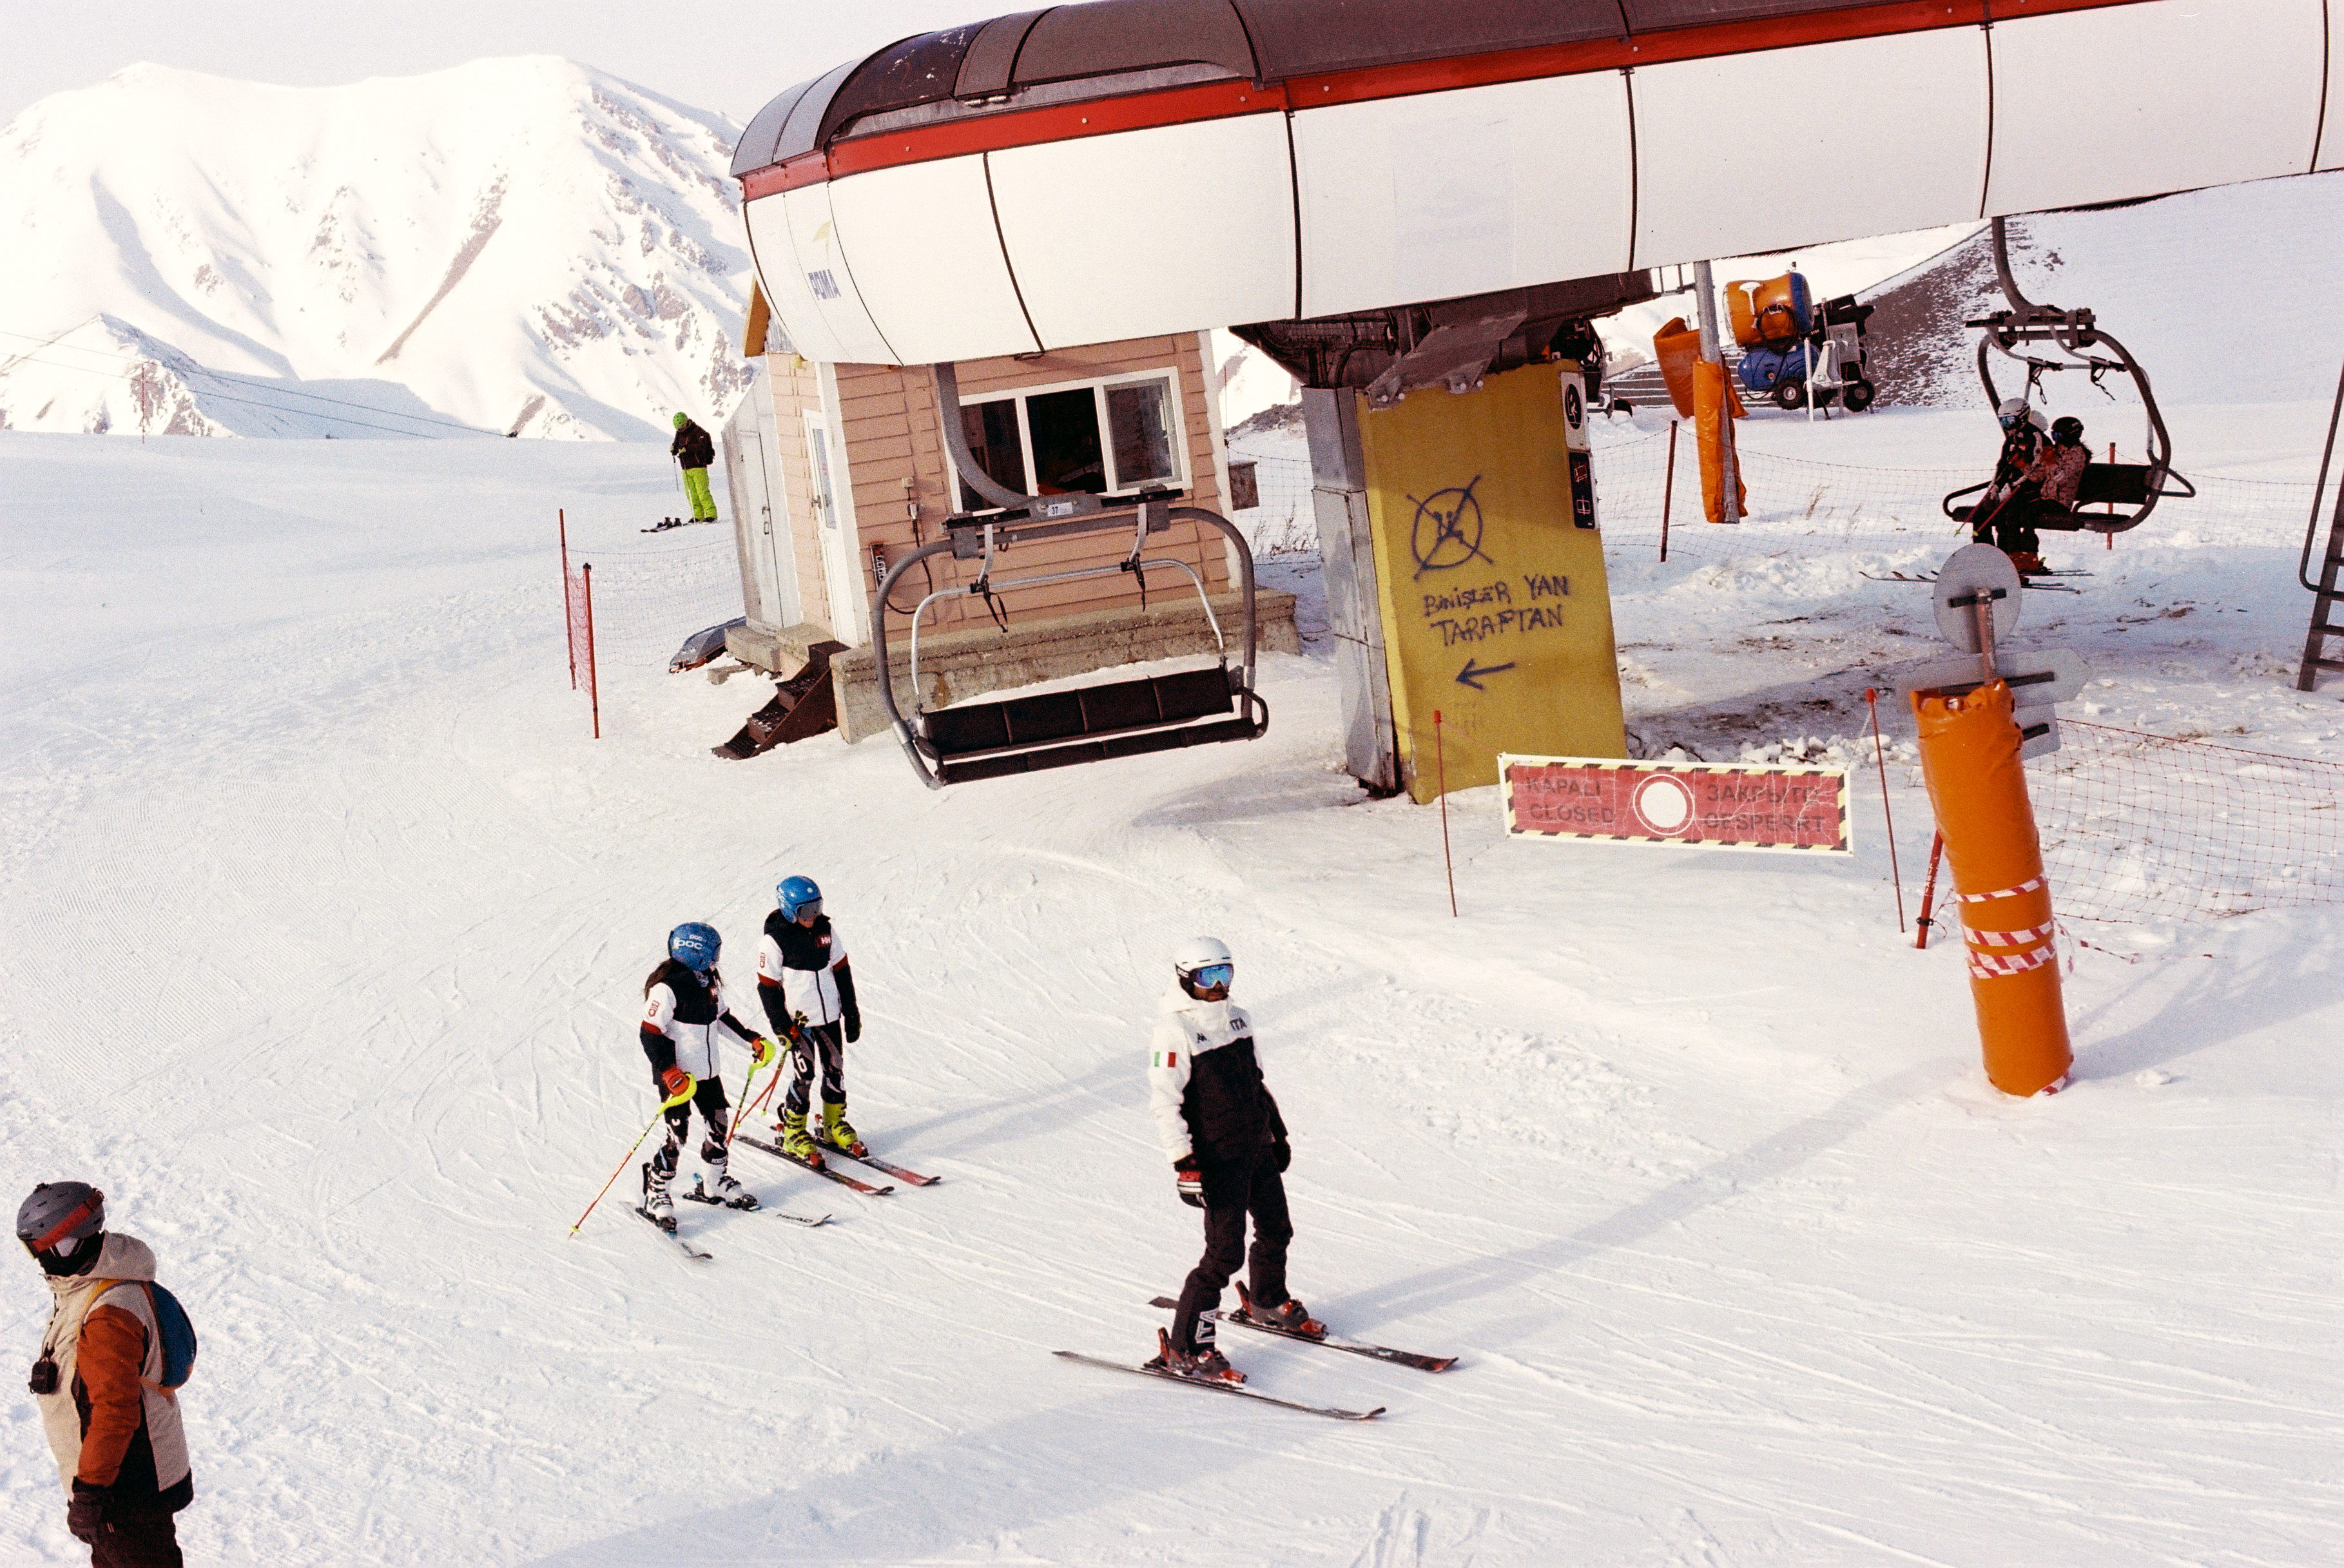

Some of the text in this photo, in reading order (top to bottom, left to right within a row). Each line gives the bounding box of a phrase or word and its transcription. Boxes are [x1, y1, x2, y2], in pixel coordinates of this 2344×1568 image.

[808, 269, 841, 300] POMA
[1051, 506, 1058, 515] 37
[1524, 574, 1568, 600] YAN
[1526, 777, 1600, 797] KAPALI
[1530, 803, 1614, 823] CLOSED
[1705, 812, 1823, 832] GESPERRT
[674, 937, 703, 950] poc
[1230, 1017, 1247, 1031] ITA
